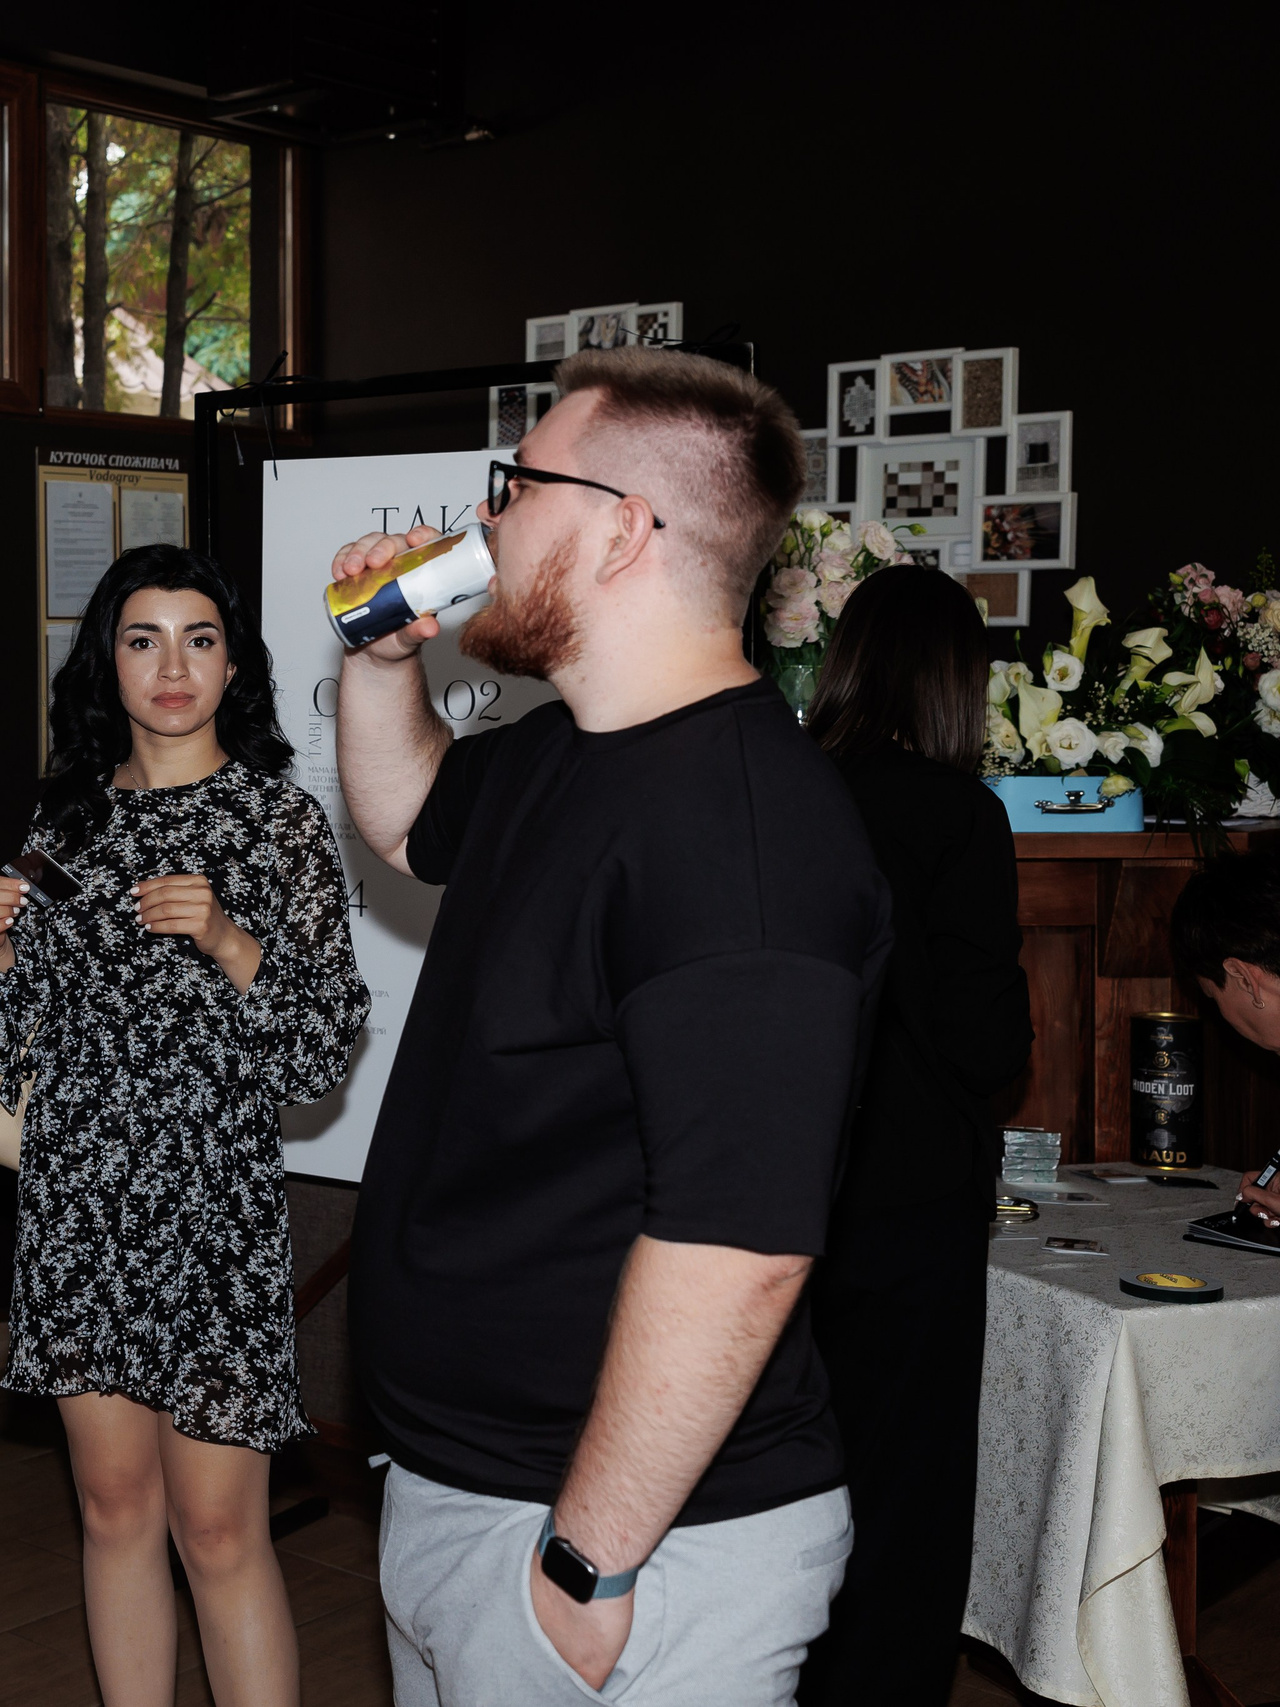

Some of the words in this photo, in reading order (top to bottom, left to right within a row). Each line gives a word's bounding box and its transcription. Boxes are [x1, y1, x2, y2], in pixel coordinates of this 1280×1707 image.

[49, 451, 108, 466] КУТОЧОК
[108, 454, 180, 470] СПОЖИВАЧА
[89, 470, 142, 486] Vodogray
[372, 504, 472, 535] TAK
[308, 708, 323, 756] TABLE
[1132, 1078, 1166, 1095] HIDDEN
[1169, 1083, 1195, 1096] LOOT
